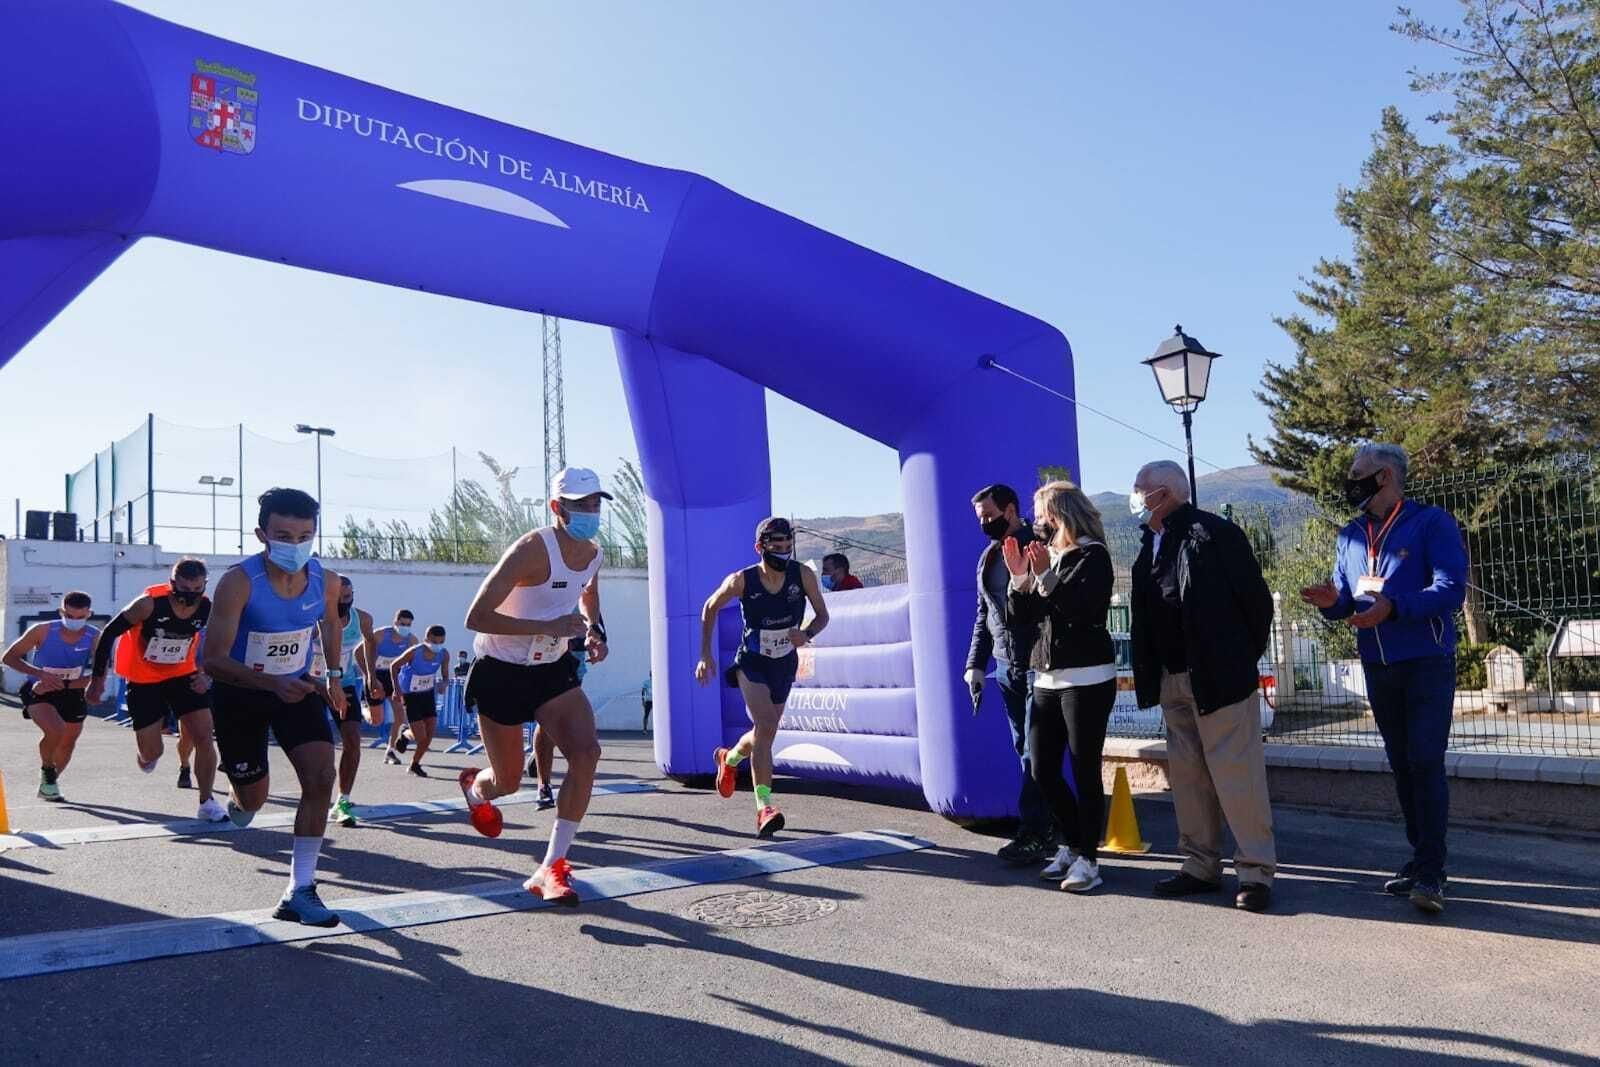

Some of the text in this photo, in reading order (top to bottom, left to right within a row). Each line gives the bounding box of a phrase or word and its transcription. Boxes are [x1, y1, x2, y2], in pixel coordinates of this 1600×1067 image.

[297, 97, 650, 213] DIPUTACIÓN DE ALMERÍA
[266, 643, 299, 657] 290
[787, 691, 849, 711] UTACIÓN
